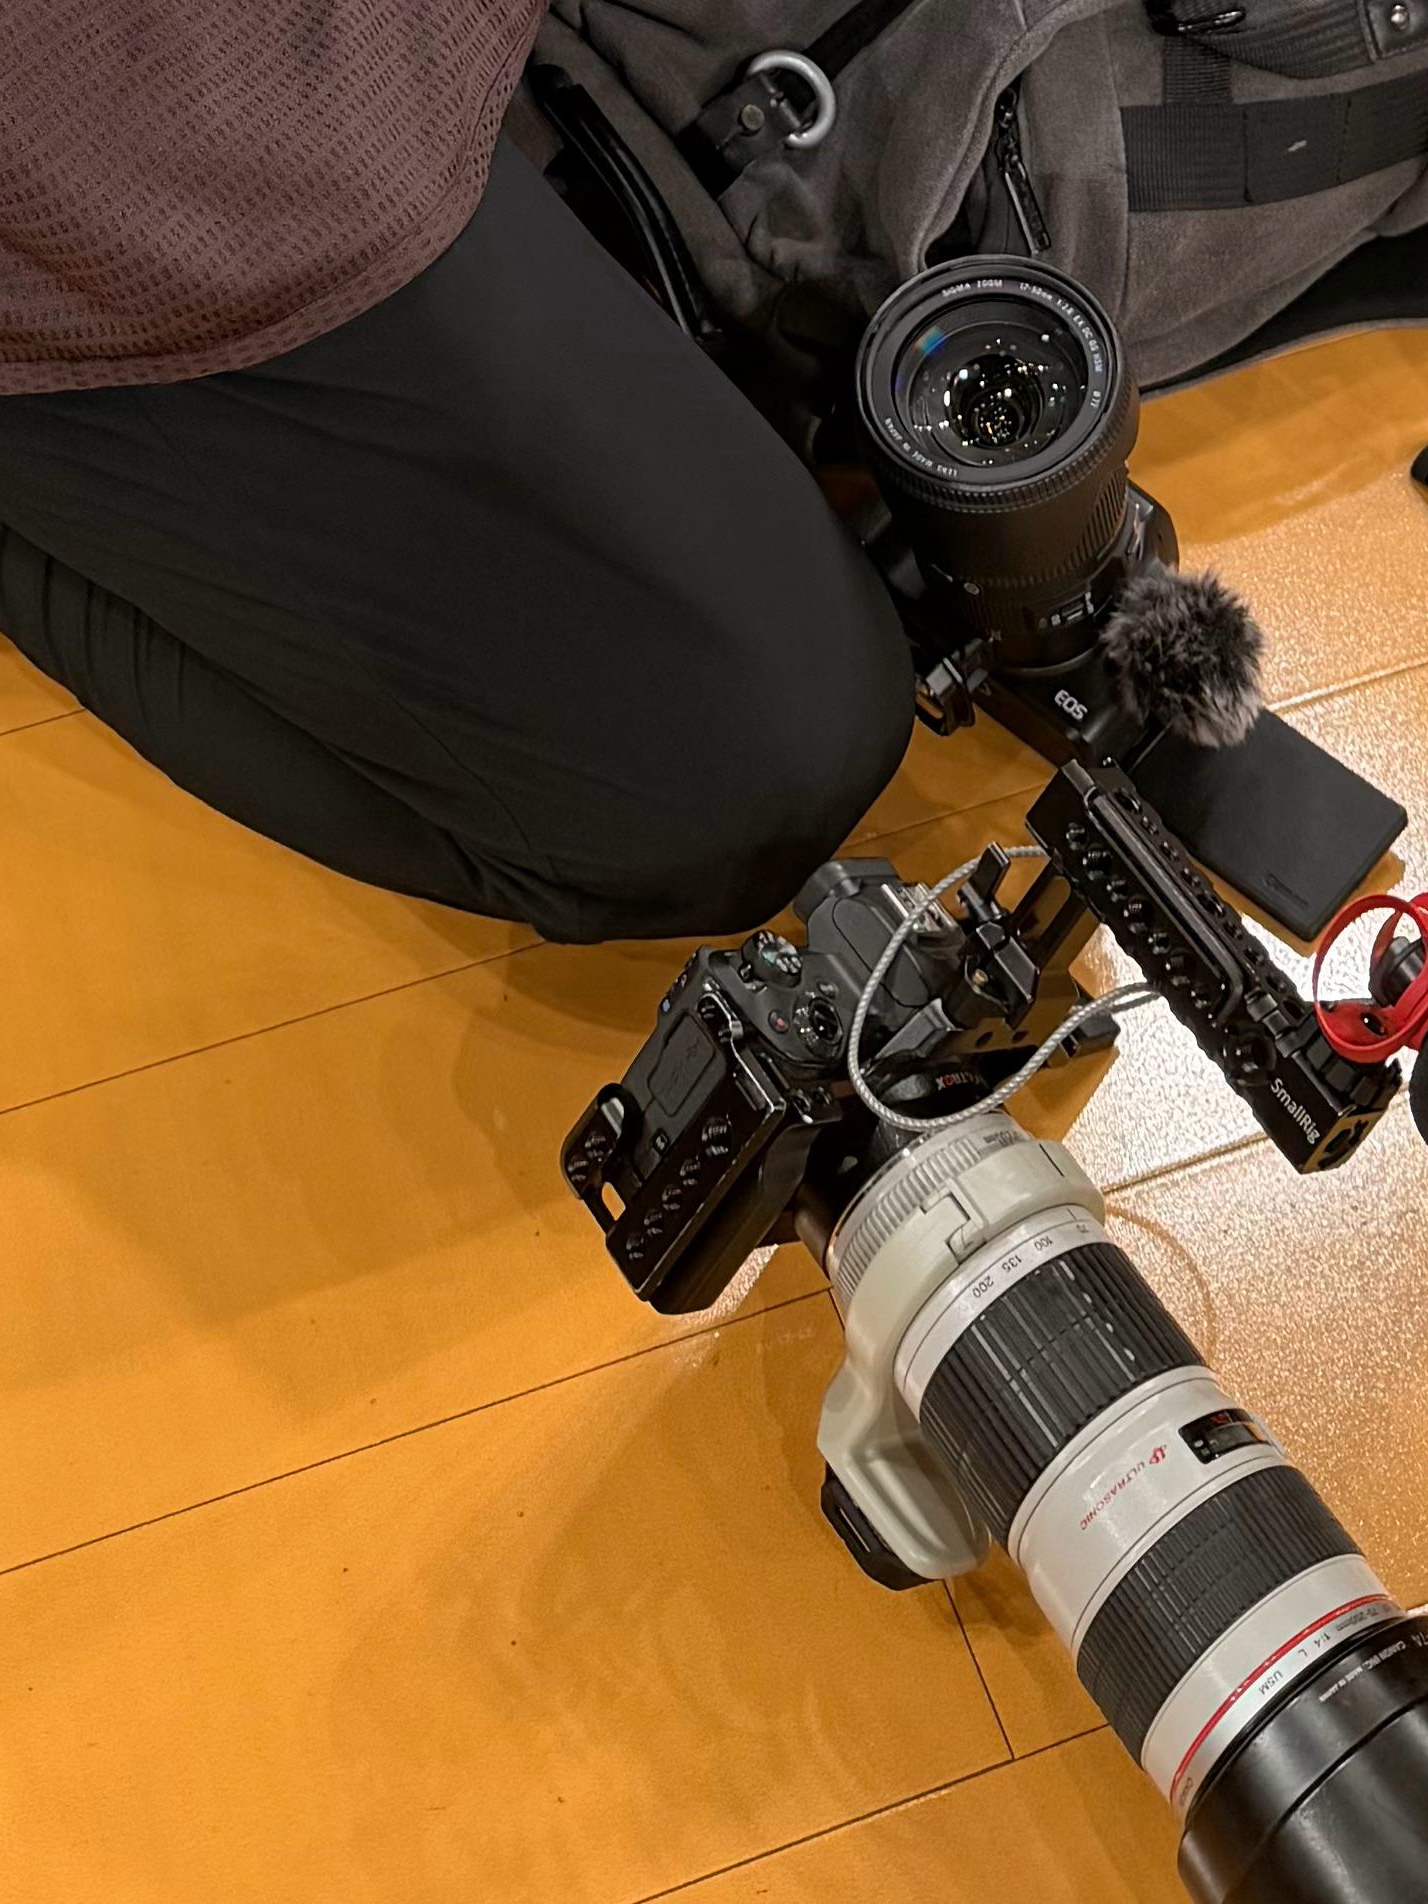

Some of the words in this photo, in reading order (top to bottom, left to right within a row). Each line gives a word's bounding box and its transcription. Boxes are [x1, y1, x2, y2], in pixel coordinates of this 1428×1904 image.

[1054, 689, 1088, 720] EOS
[1270, 1077, 1322, 1145] SmallRig
[1033, 1234, 1054, 1252] 100
[1000, 1253, 1023, 1274] 135
[971, 1274, 995, 1299] 200
[1079, 1459, 1146, 1532] ULTRASONIC
[1297, 1648, 1309, 1659] L
[1257, 1669, 1285, 1697] USM
